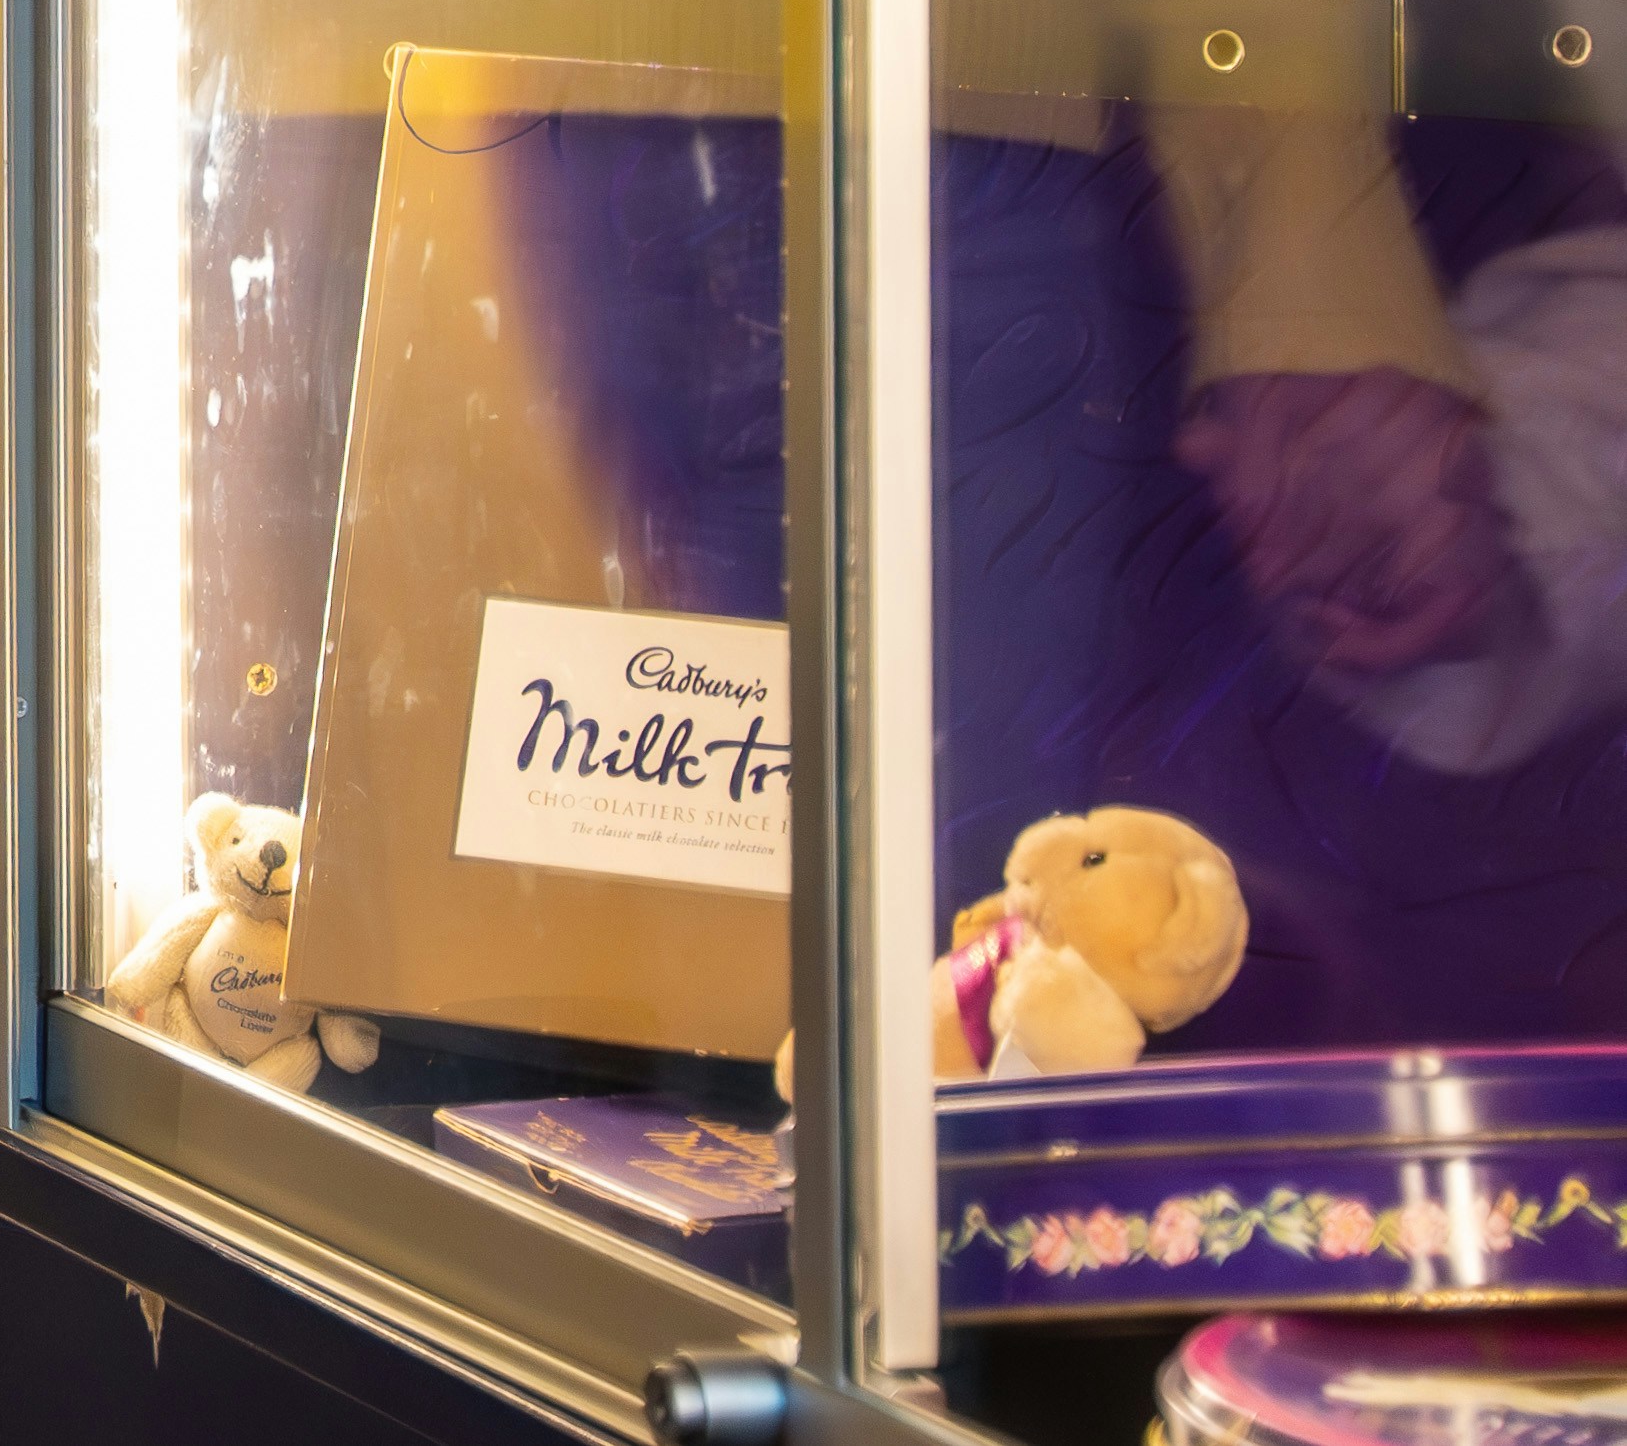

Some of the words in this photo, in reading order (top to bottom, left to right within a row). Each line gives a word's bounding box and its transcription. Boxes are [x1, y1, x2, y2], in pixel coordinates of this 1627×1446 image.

[625, 646, 768, 709] Cadbury's
[516, 678, 707, 789] Milk
[527, 789, 697, 824] CHOCOLATIERS
[704, 810, 771, 832] SINCE
[572, 821, 593, 835] The
[596, 826, 633, 840] classic
[636, 830, 663, 843] milk
